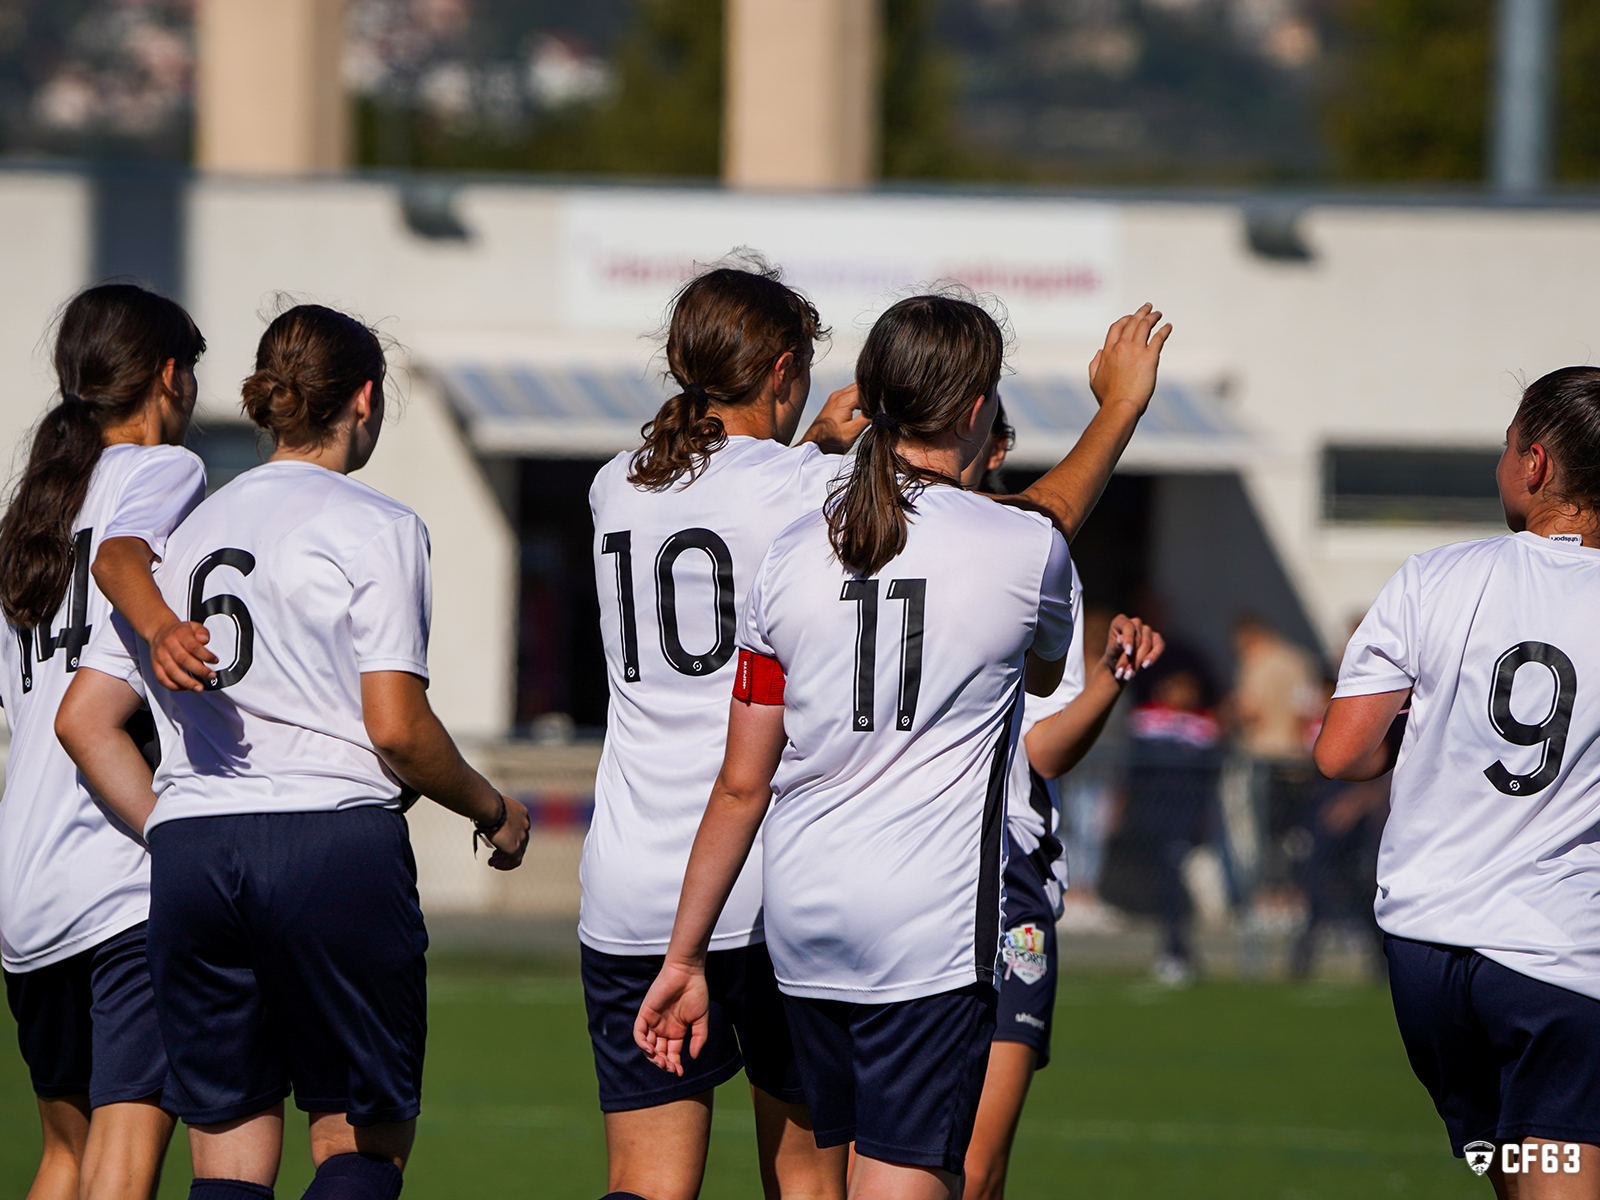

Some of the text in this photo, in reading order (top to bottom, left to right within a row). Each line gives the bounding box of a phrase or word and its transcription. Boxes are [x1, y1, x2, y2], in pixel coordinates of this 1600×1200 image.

[187, 548, 256, 691] 6
[601, 527, 736, 683] 10
[839, 578, 927, 732] 11
[1483, 641, 1577, 796] 9
[1006, 950, 1046, 967] SPORT
